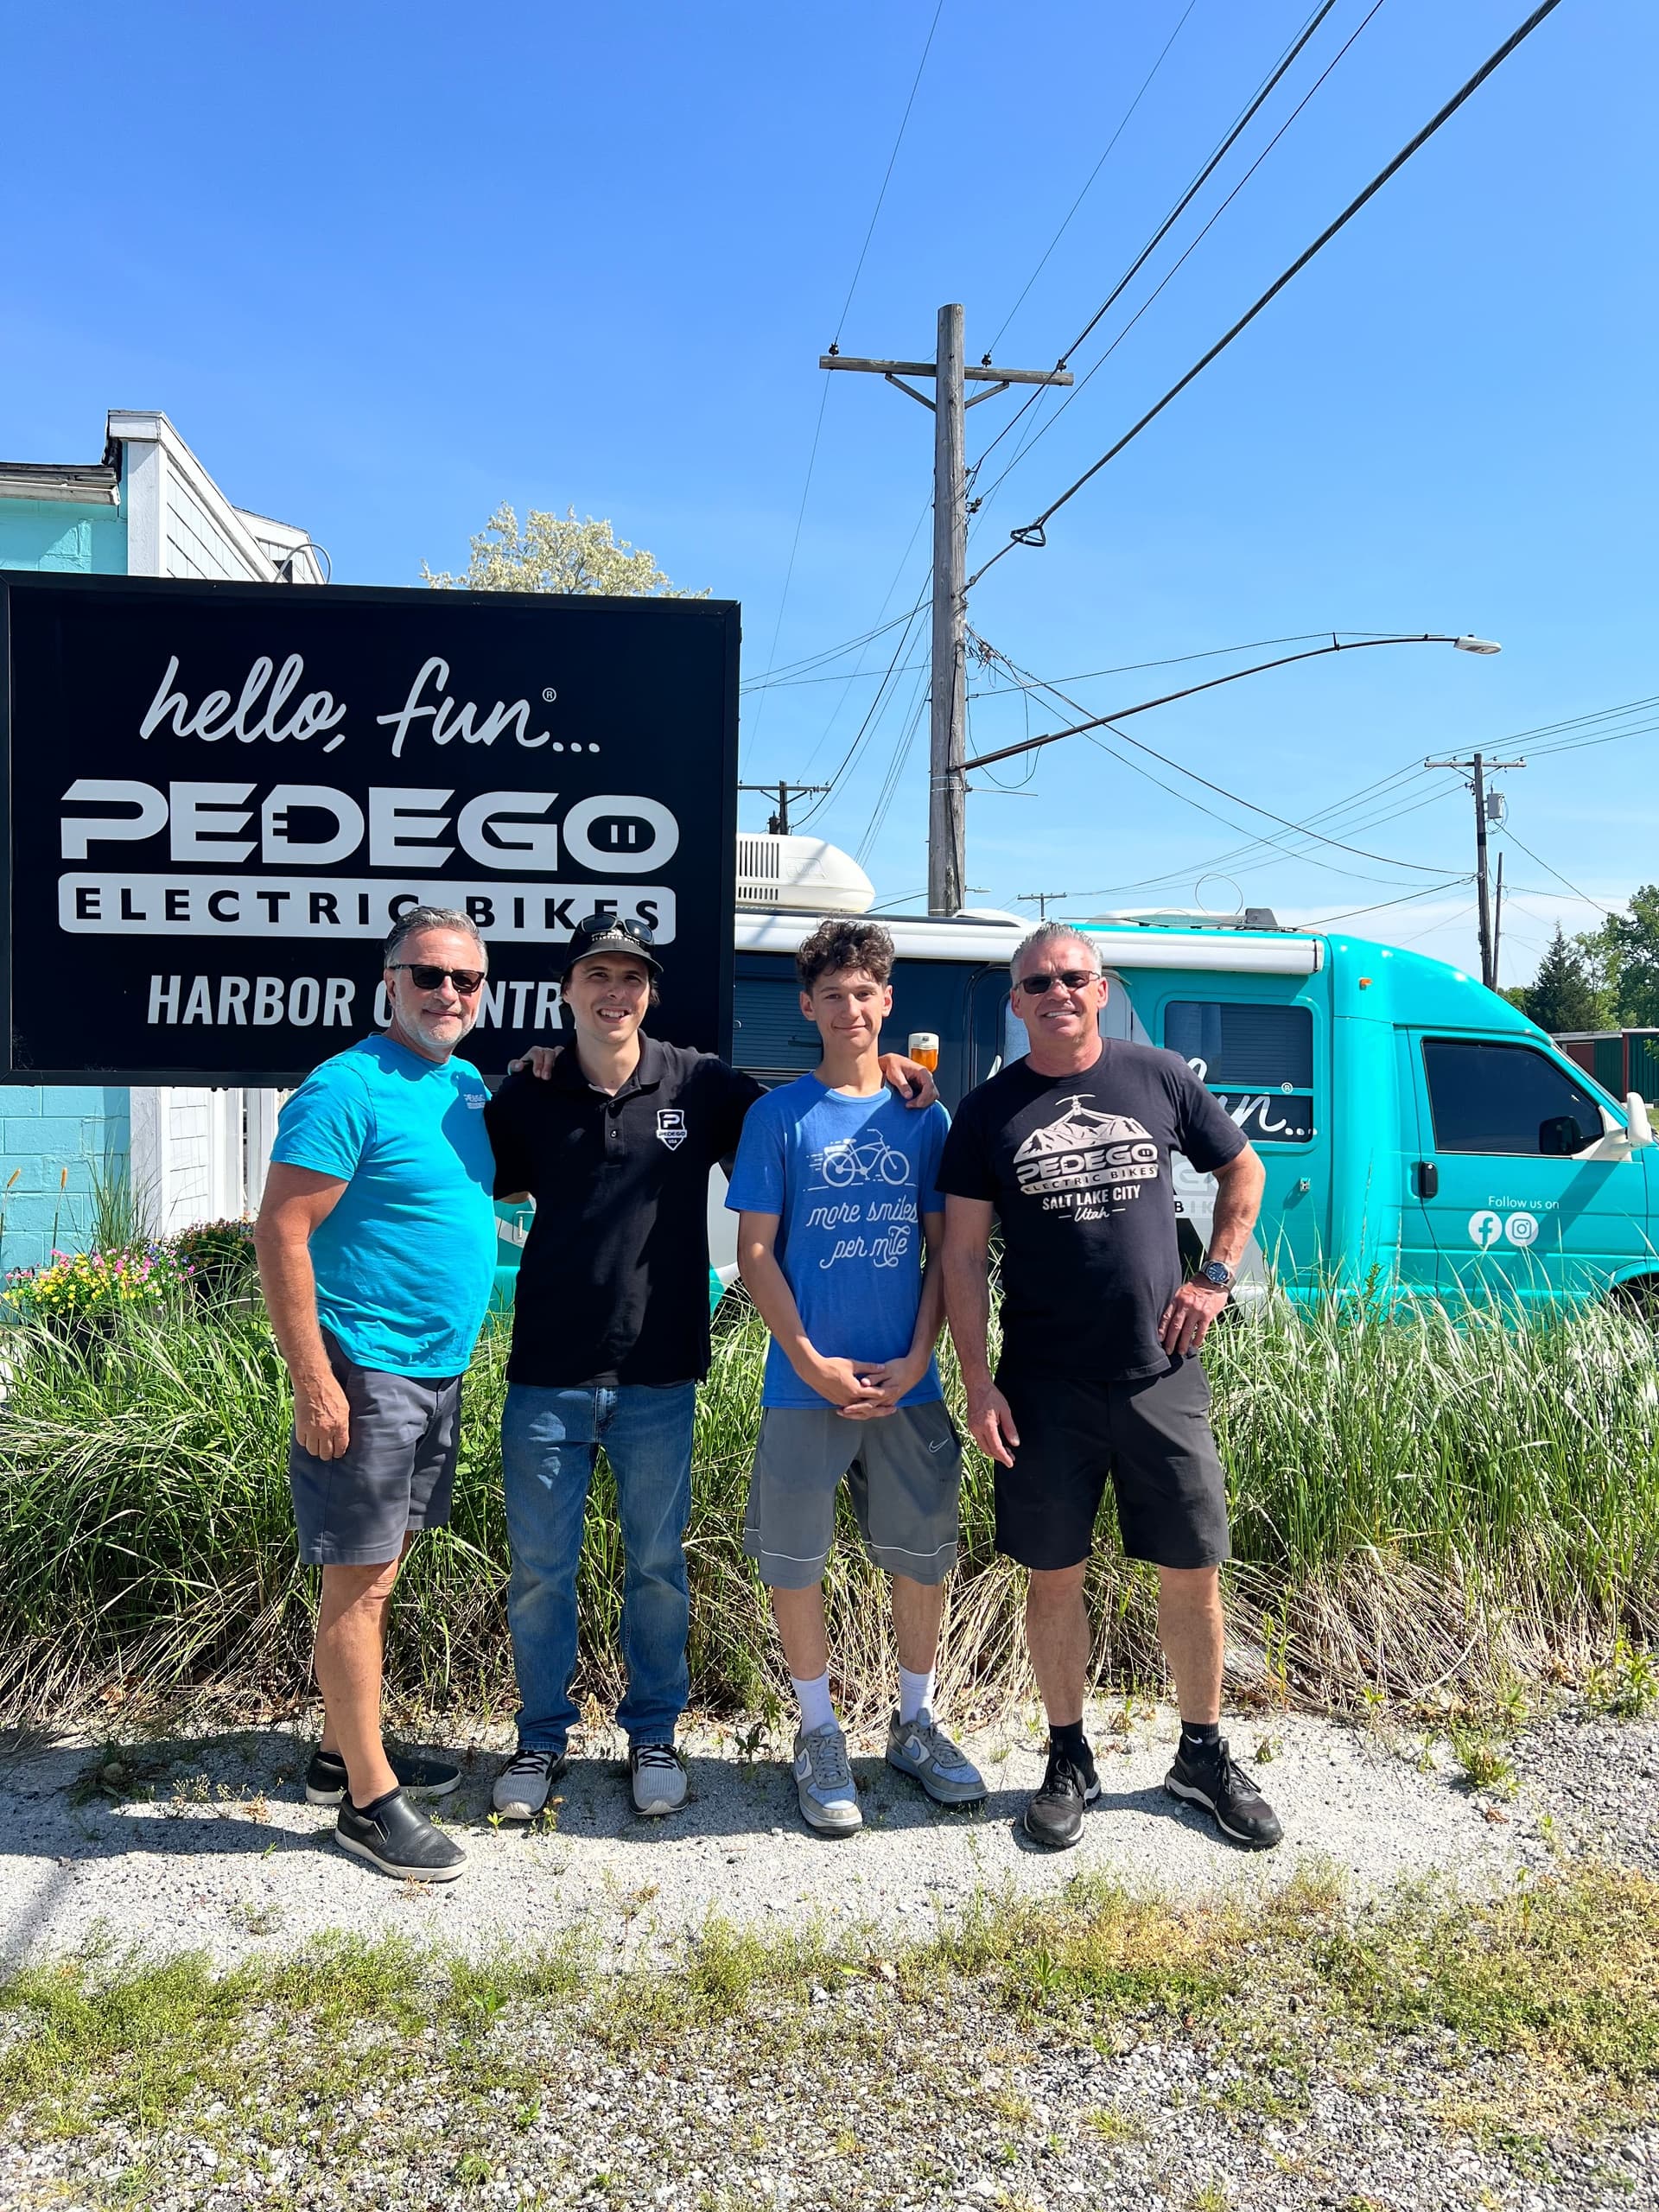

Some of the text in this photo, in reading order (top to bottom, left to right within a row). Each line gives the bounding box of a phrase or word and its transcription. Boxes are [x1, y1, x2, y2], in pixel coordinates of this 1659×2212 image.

[139, 652, 346, 753] hello,
[60, 779, 680, 874] PEDEGO
[148, 974, 355, 1027] HARBOR
[1015, 1142, 1159, 1185] PEDEGO
[1025, 1174, 1101, 1192] ELECTRIC
[1111, 1166, 1155, 1179] BIKES
[805, 1194, 918, 1230] more smiles
[1042, 1185, 1141, 1211] SALT LAKE CITY
[1074, 1206, 1110, 1223] Utah
[1488, 1195, 1560, 1211] Follow us on
[819, 1225, 912, 1269] per mile
